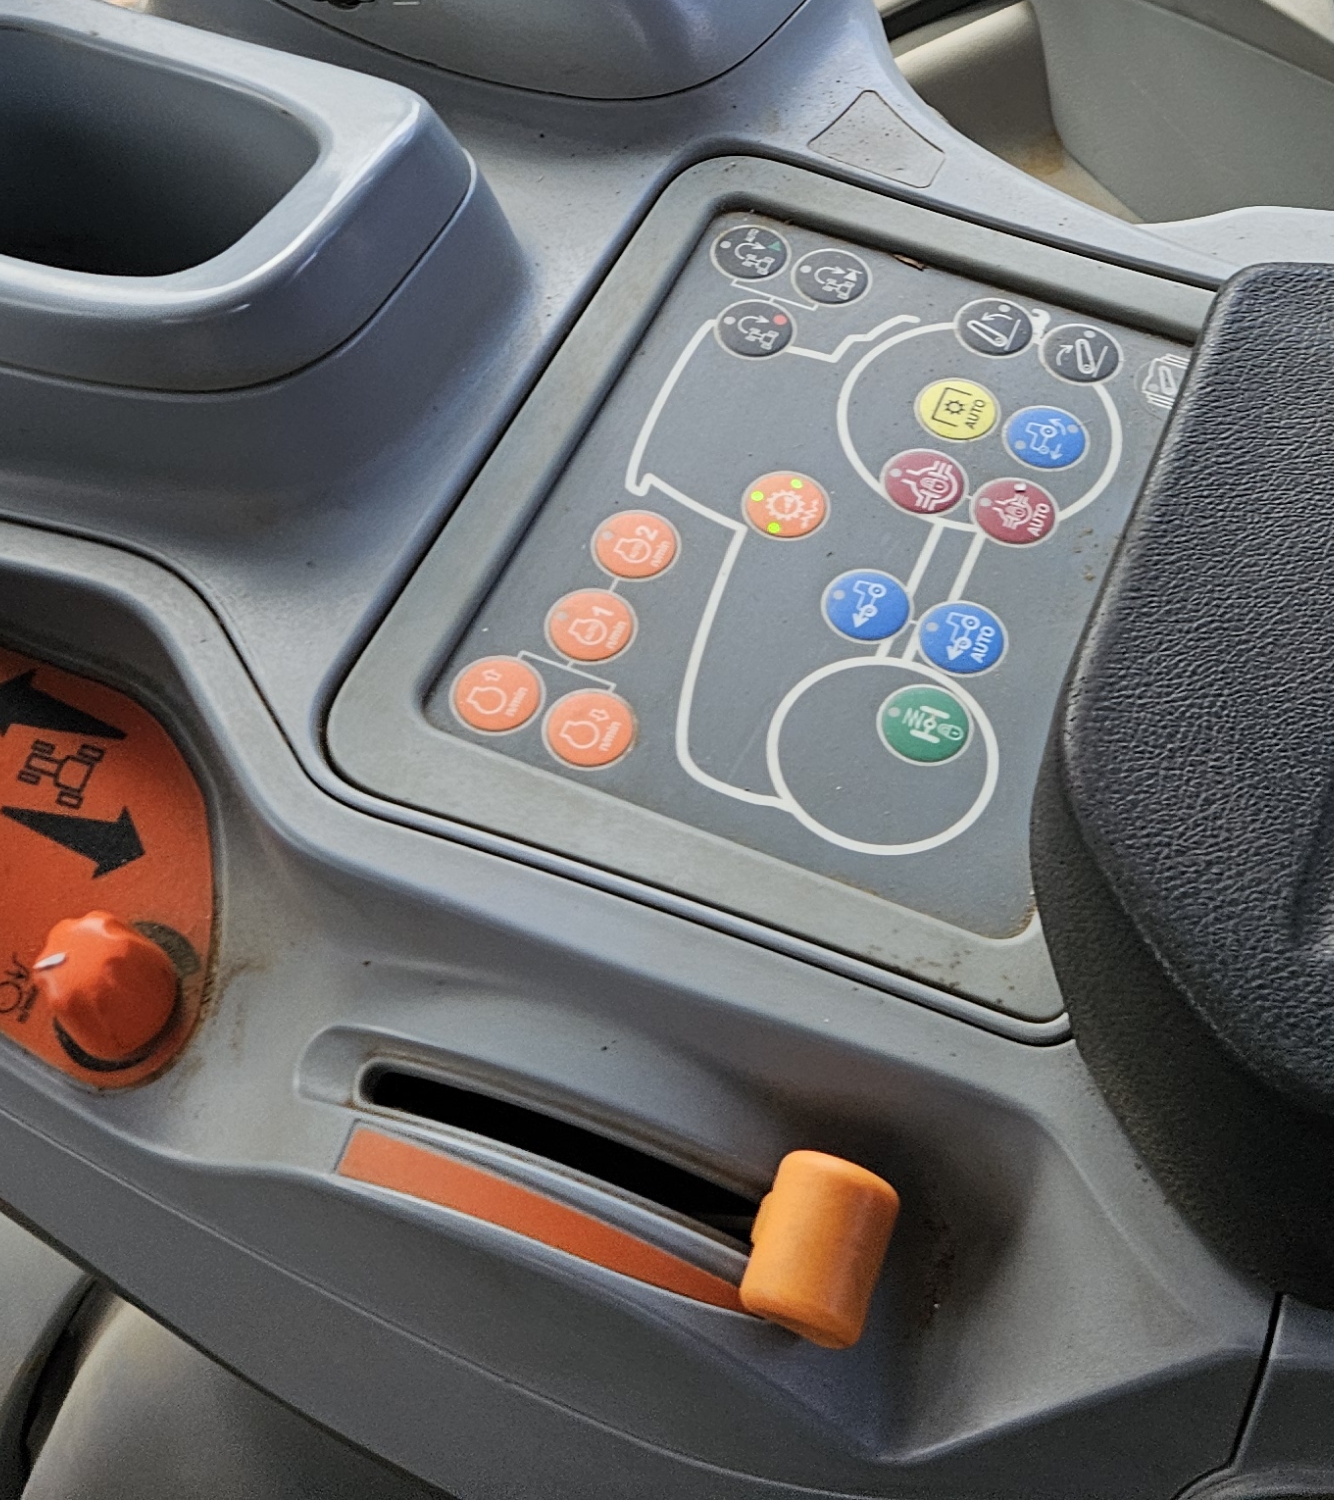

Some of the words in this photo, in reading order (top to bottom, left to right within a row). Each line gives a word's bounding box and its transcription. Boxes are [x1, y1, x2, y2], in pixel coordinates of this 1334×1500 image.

[965, 399, 986, 430] AUTO
[635, 525, 659, 541] 2
[1027, 503, 1051, 537] AUTO
[591, 605, 614, 617] 1
[970, 626, 996, 664] AUTO
